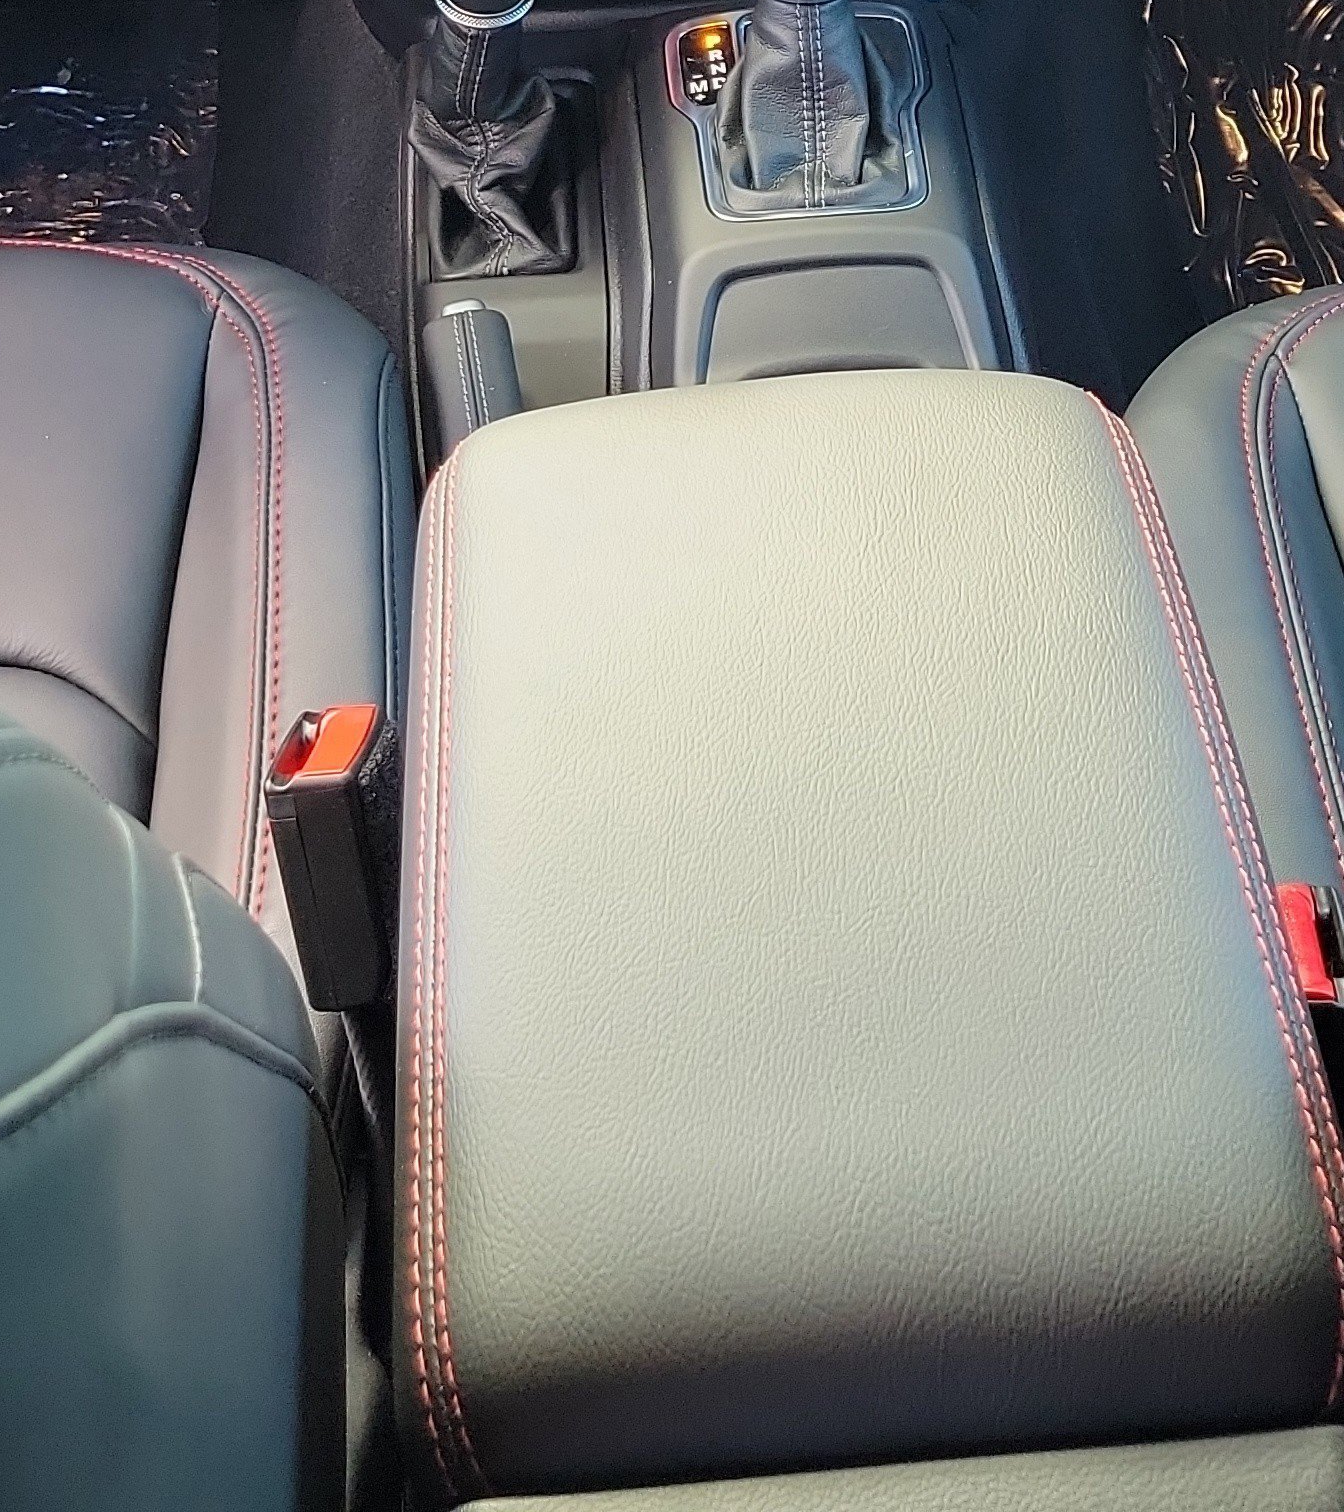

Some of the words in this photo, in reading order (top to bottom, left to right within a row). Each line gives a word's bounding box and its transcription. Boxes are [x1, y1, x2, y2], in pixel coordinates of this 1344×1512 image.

[708, 49, 724, 62] R
[711, 62, 727, 75] N
[689, 79, 709, 94] M
